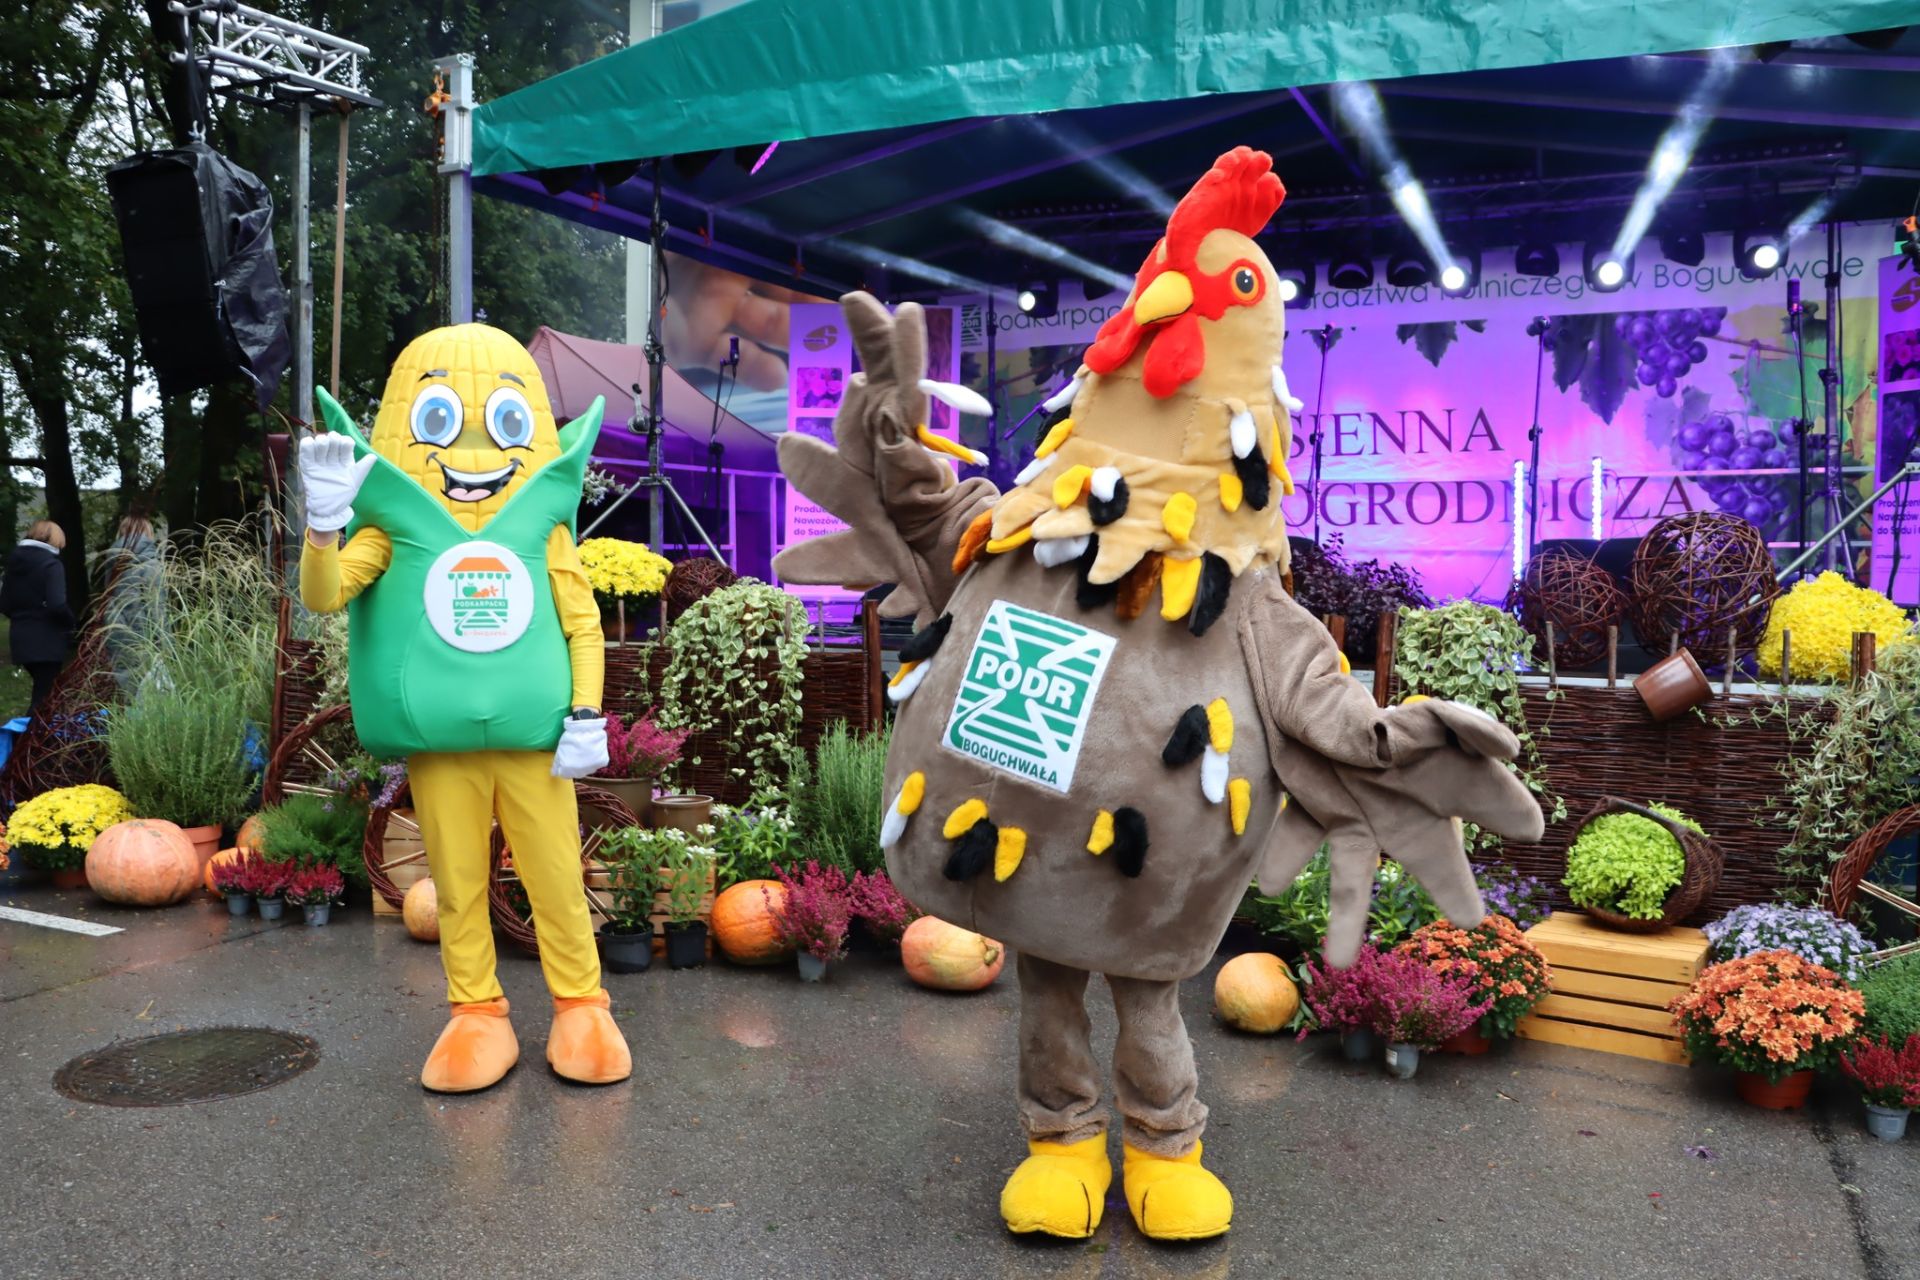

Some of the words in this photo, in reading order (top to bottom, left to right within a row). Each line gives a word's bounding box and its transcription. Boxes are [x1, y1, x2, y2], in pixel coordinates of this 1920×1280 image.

[794, 528, 805, 536] do
[1877, 527, 1889, 535] do
[455, 600, 506, 608] PODKARPACKI
[974, 652, 1076, 711] PODR
[963, 736, 1058, 785] BOGUCHWAŁA
